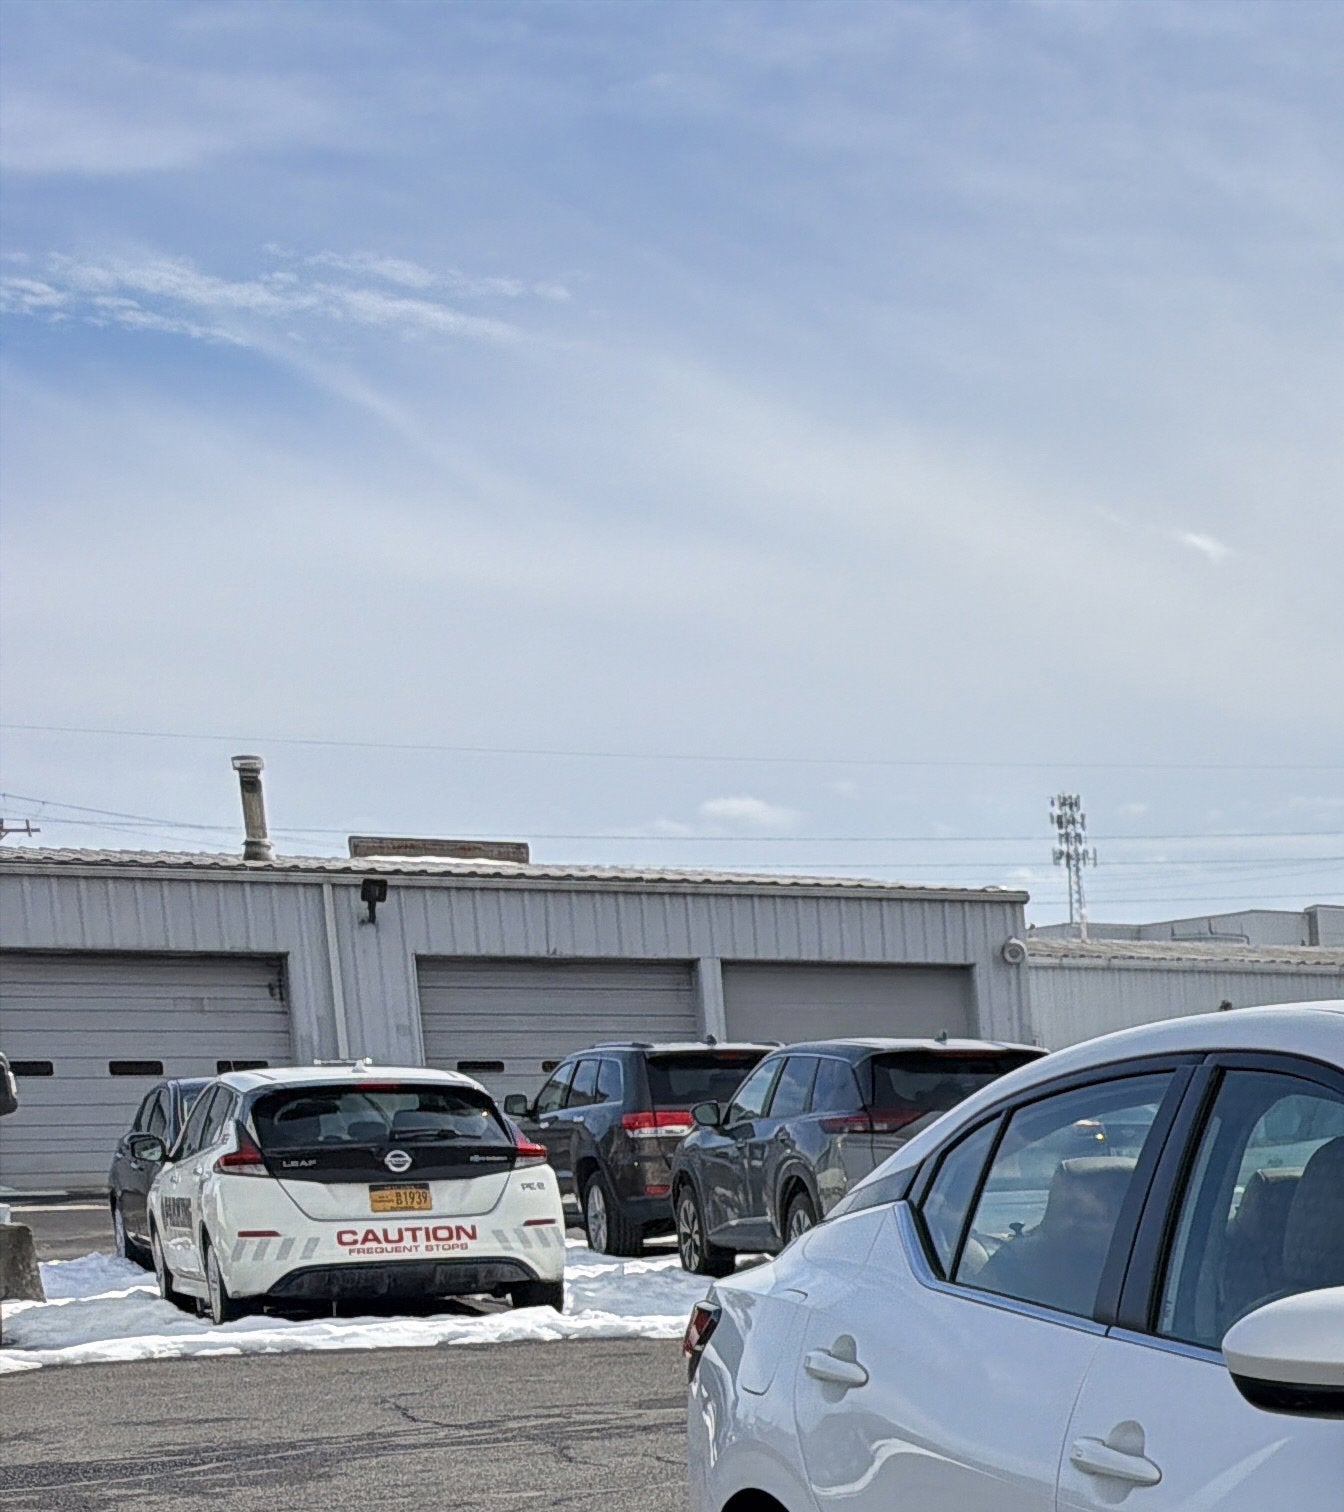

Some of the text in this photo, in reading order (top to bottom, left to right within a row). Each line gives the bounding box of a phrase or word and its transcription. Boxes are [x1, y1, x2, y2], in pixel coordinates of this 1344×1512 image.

[336, 1224, 478, 1247] CAUTION
[348, 1242, 469, 1256] FREQUENT STOPS
